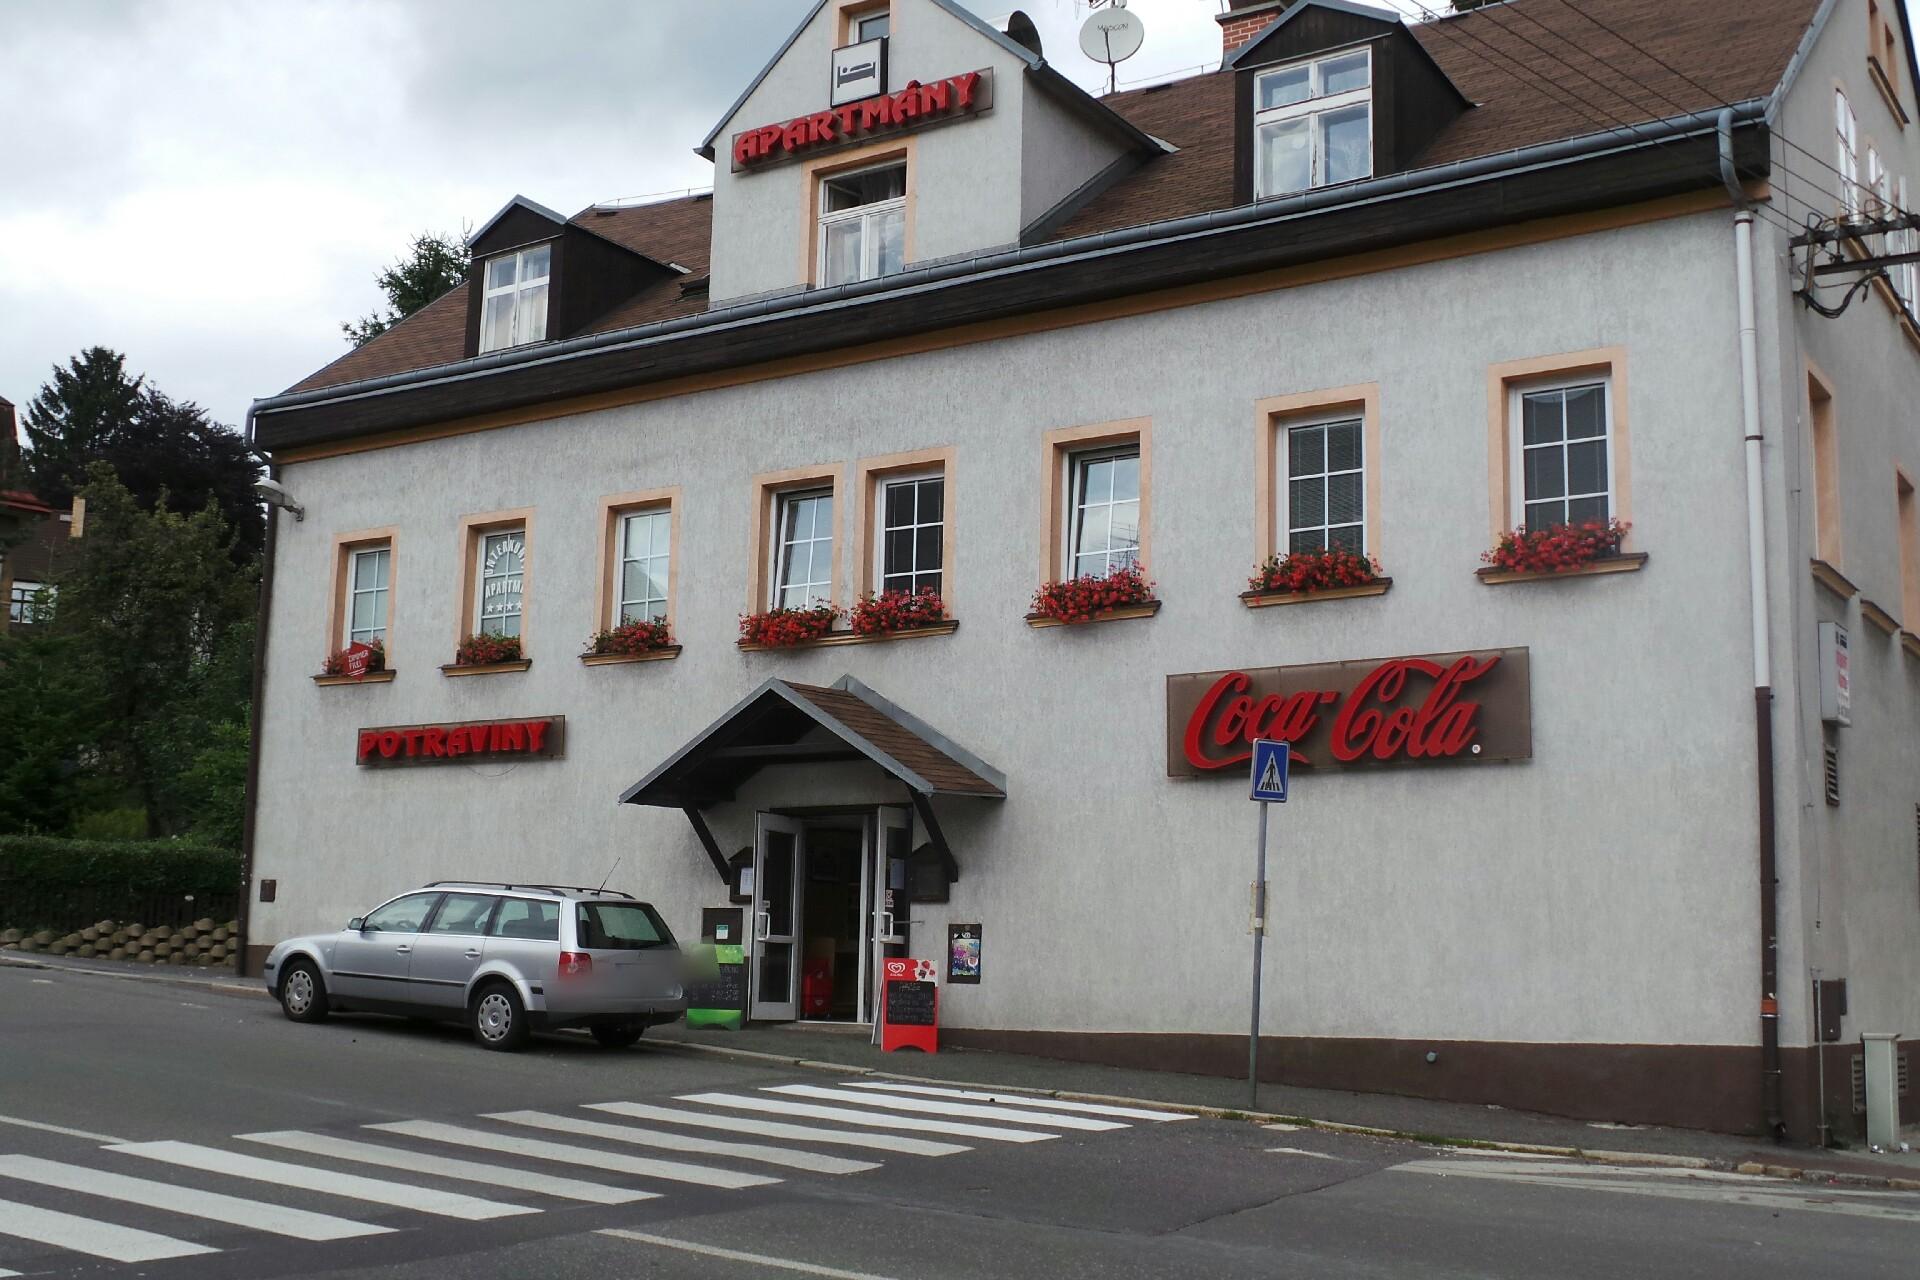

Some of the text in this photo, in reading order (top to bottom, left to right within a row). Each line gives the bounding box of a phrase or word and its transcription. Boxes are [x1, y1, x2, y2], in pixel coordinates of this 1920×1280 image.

[734, 71, 982, 165] APARTMÁNY
[359, 721, 551, 759] POTRAVINY
[1184, 656, 1502, 769] Coca-Cola
